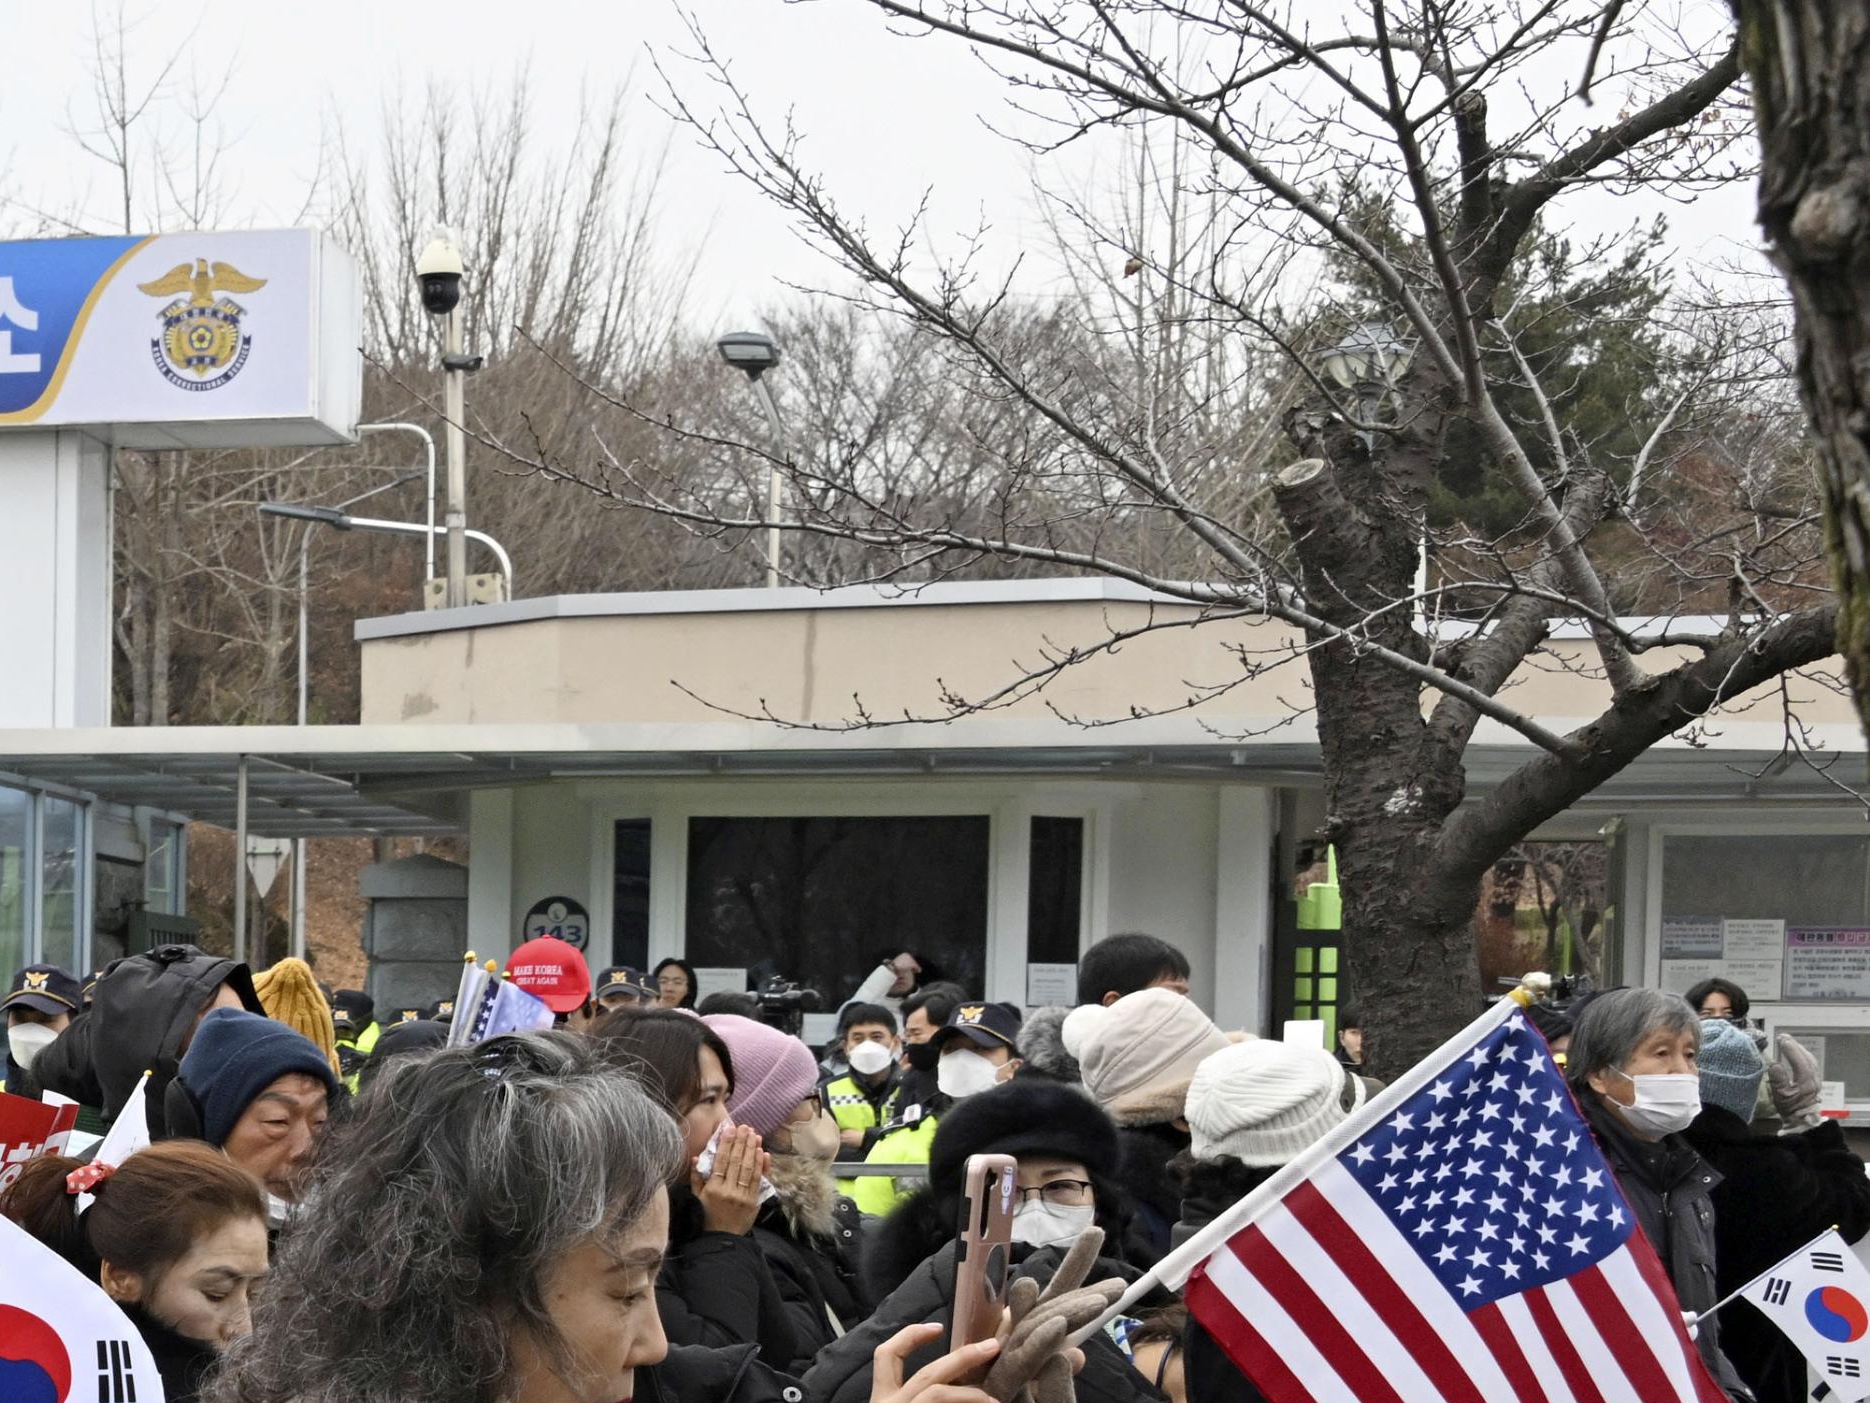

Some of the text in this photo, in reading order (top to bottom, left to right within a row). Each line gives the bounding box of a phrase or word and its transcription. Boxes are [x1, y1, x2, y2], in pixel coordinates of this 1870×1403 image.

[533, 925, 581, 943] 143
[513, 964, 563, 976] MAKE KOREA
[536, 977, 558, 985] AGAIN
